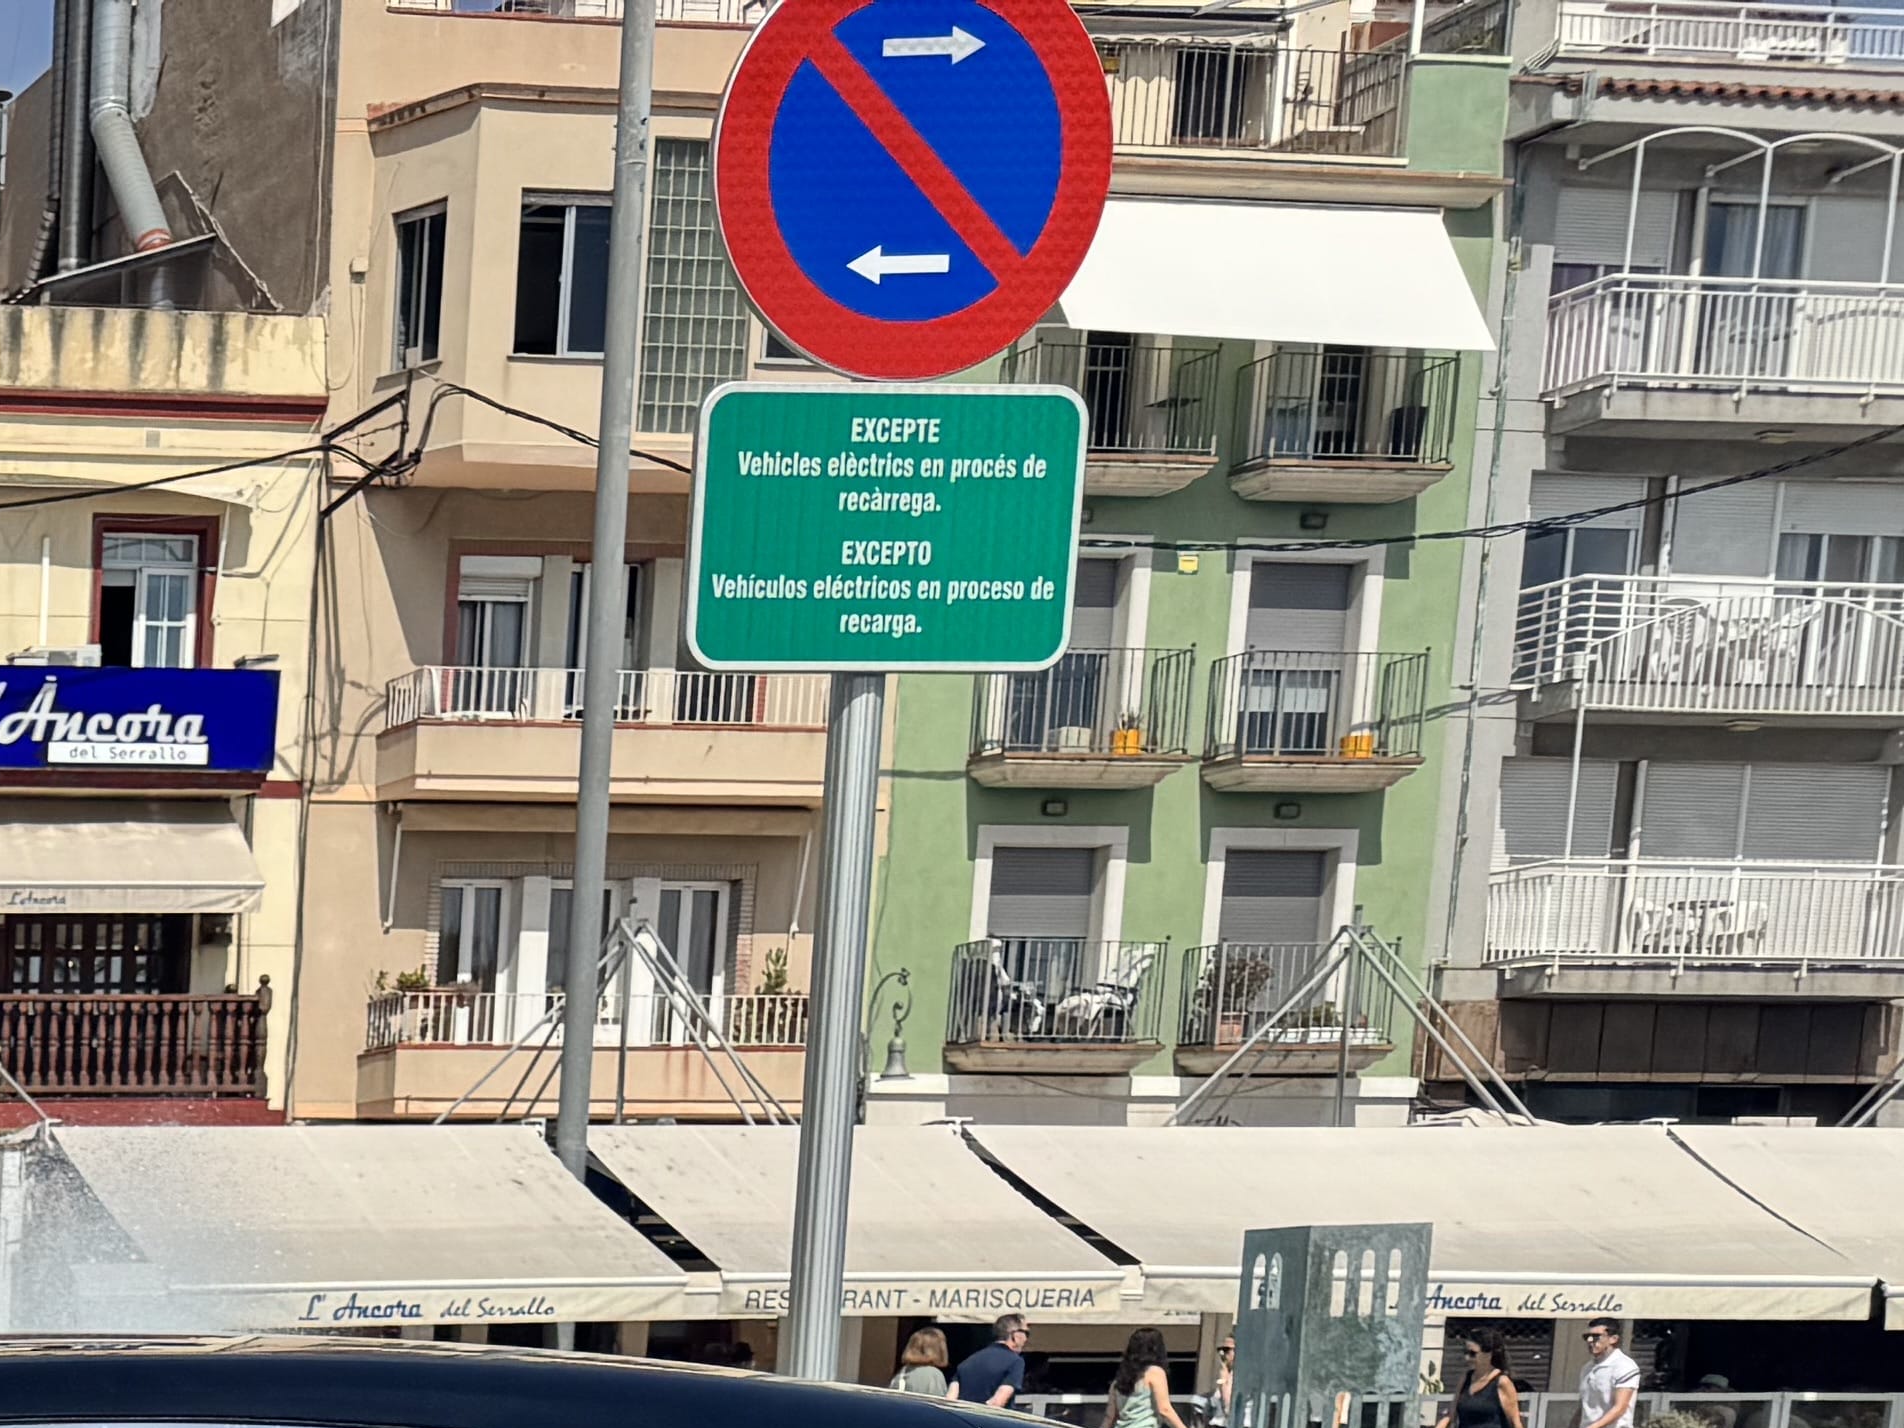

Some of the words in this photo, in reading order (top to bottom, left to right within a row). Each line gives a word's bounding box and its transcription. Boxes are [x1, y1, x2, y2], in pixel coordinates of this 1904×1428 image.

[850, 417, 941, 444] EXCEPTE
[737, 451, 822, 478] Vehicles
[827, 451, 917, 479] elèctrics
[920, 460, 945, 479] en
[950, 453, 1019, 485] procés
[1022, 453, 1047, 480] de
[838, 487, 942, 516] recàrrega.
[841, 540, 932, 566] EXCEPTO
[711, 573, 808, 600] Vehículos
[812, 574, 914, 600] eléctricos
[917, 582, 942, 601] en
[946, 582, 1026, 606] proceso
[1029, 575, 1055, 602] de
[839, 612, 923, 637] recarga.
[68, 745, 99, 761] del
[109, 745, 188, 762] Serrallo
[440, 1298, 472, 1319] del
[477, 1296, 555, 1318] Serrallo
[929, 1287, 1096, 1311] MARISQUERIA
[1550, 1293, 1624, 1312] Serrallo
